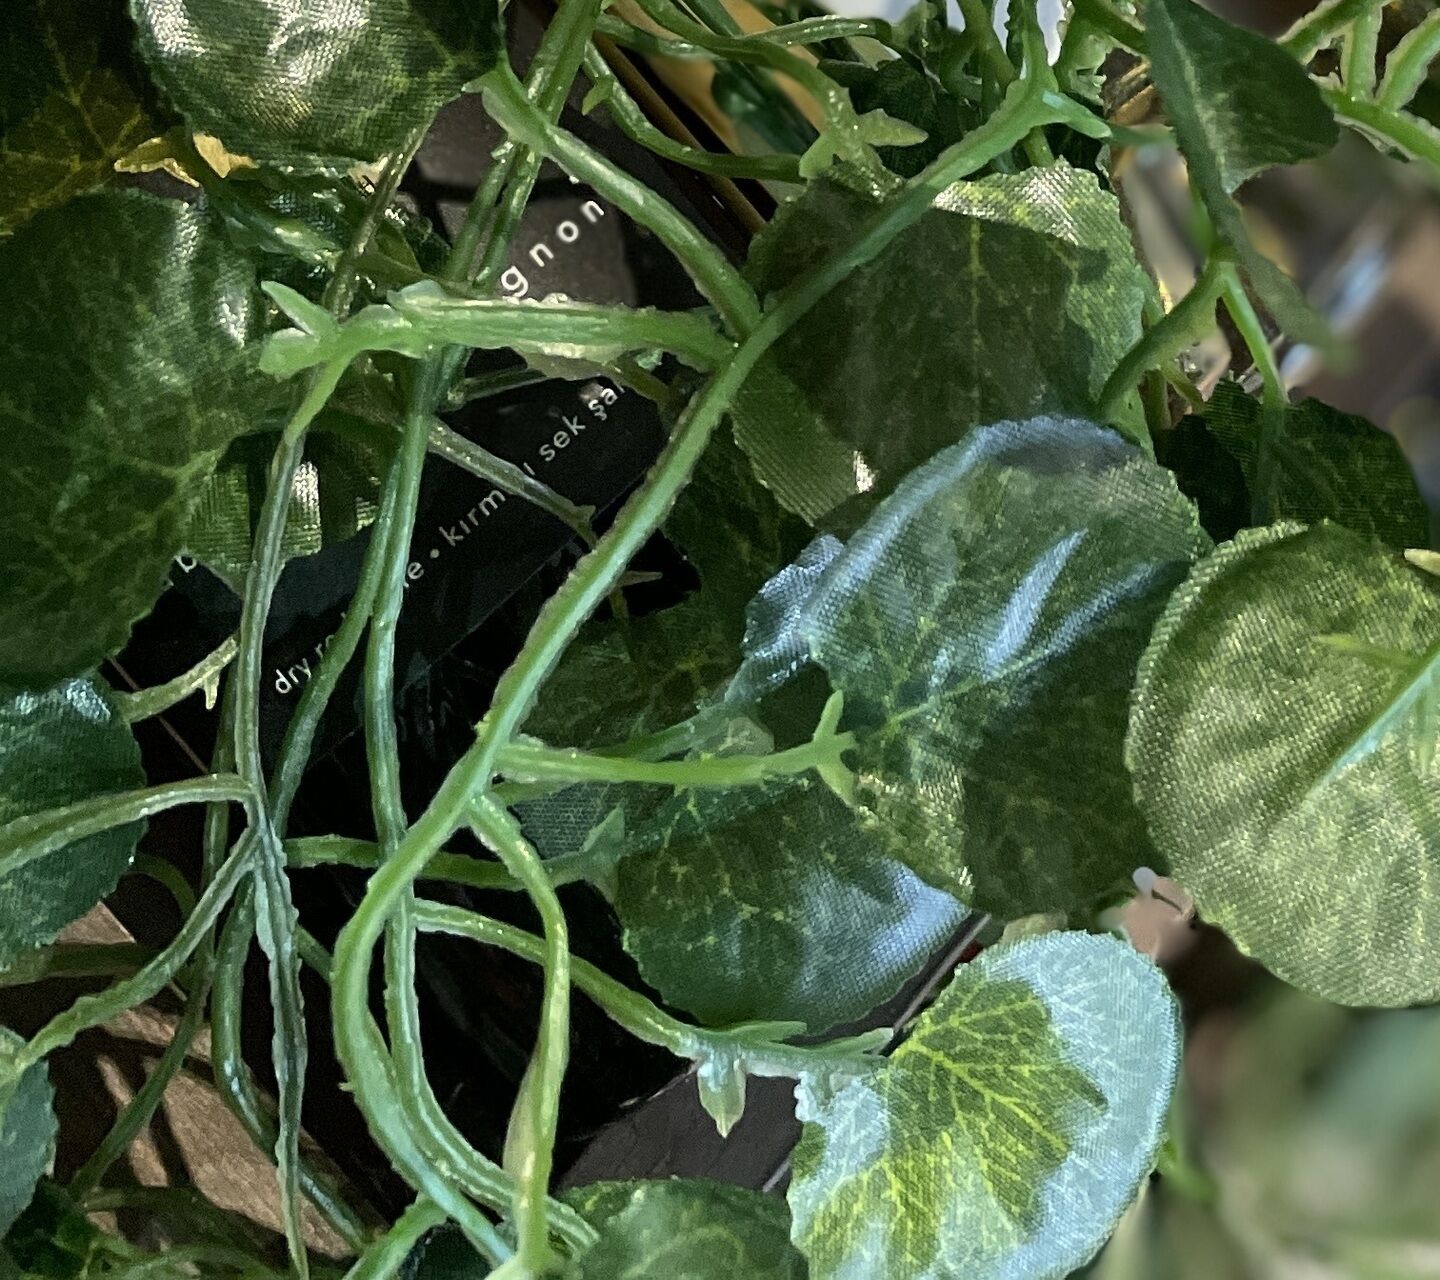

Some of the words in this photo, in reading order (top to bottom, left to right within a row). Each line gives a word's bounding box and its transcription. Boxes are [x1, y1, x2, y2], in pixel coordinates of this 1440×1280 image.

[501, 200, 605, 297] gnon
[275, 658, 312, 694] dry
[538, 415, 586, 462] sek
